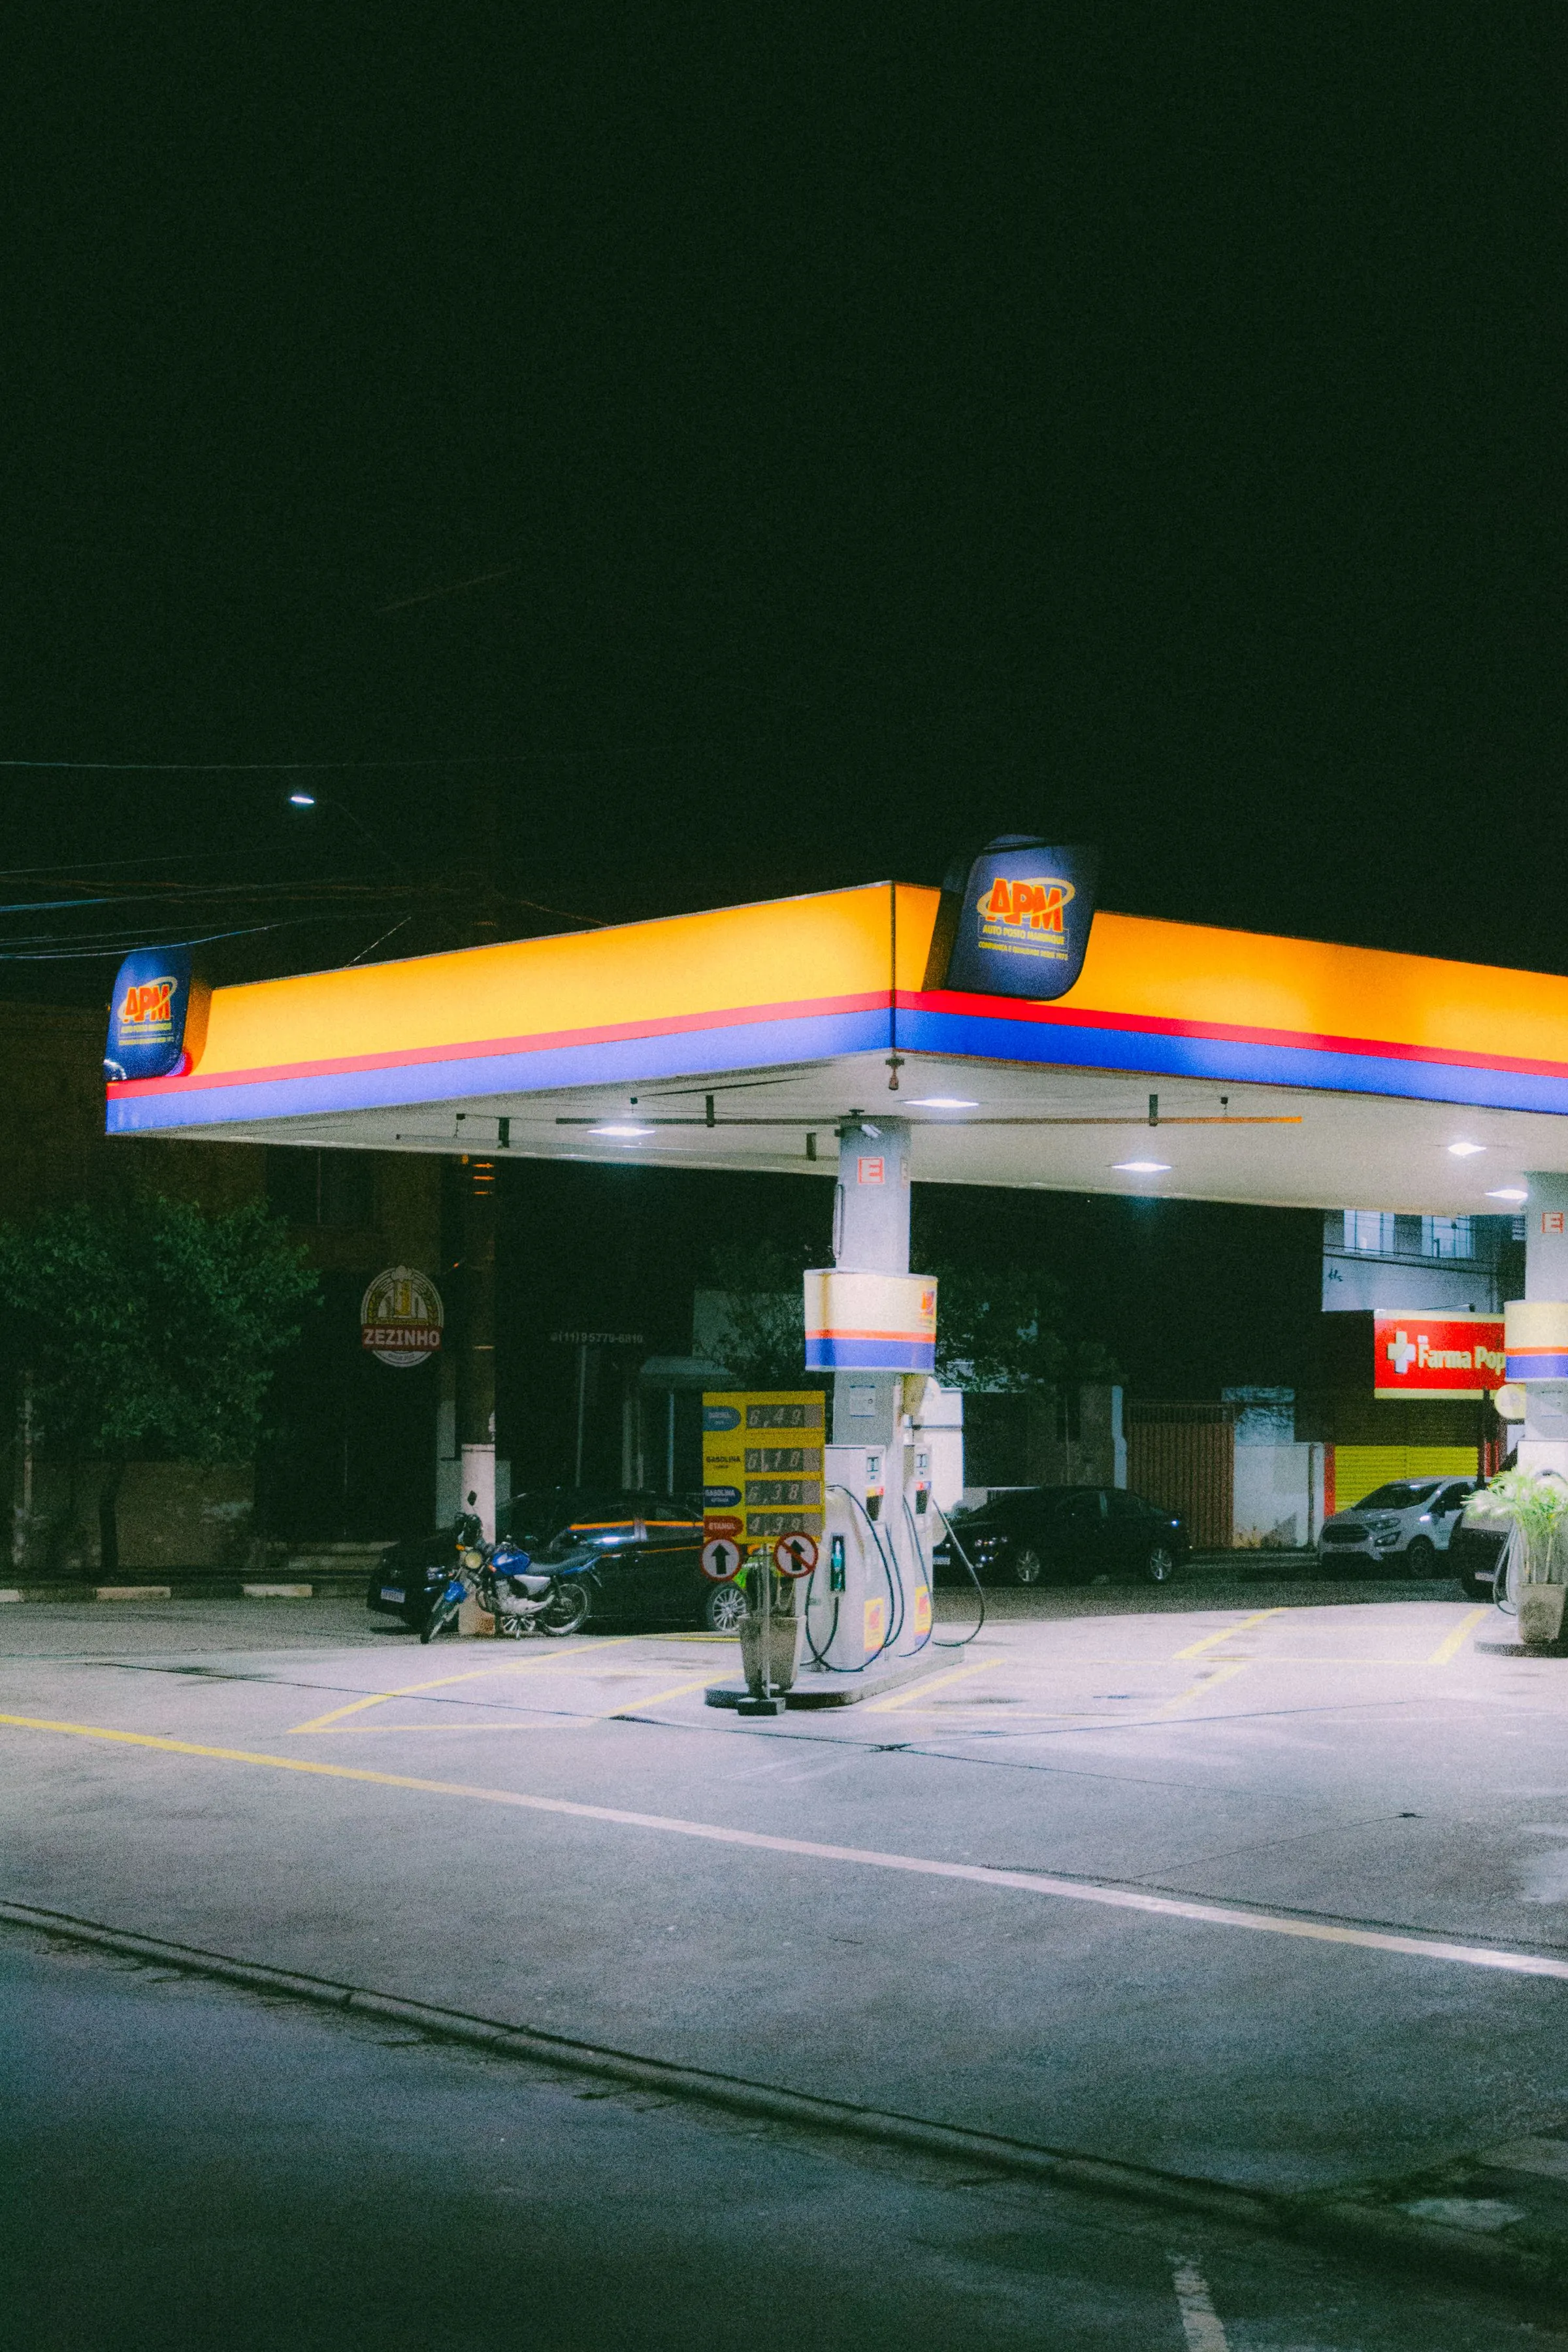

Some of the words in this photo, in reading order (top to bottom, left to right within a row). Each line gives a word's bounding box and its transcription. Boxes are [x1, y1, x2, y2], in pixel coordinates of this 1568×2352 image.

[985, 877, 1063, 932] APM
[983, 925, 1002, 936] AUTO
[1003, 928, 1026, 939] POSTO
[122, 984, 171, 1024] APM
[860, 1158, 882, 1183] E
[1543, 1213, 1562, 1233] E
[363, 1328, 440, 1347] ZEZINHO
[1418, 1345, 1471, 1369] Farma
